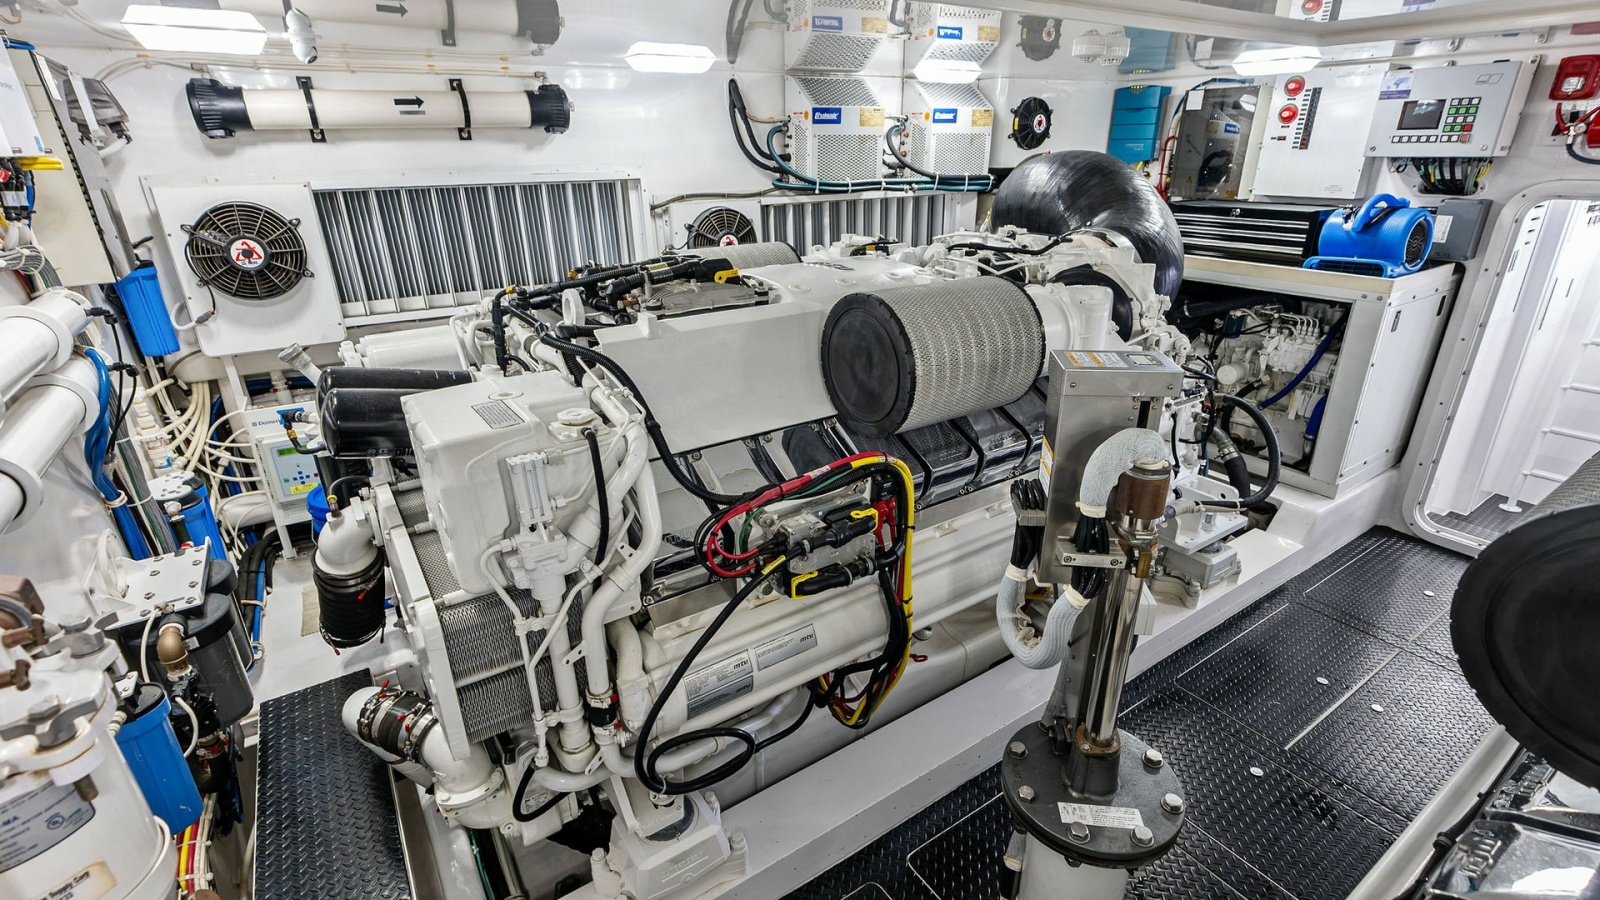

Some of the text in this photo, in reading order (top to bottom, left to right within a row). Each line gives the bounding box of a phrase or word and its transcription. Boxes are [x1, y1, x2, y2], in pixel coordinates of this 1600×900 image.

[799, 634, 814, 643] mtu
[733, 660, 748, 669] mtu
[49, 882, 73, 898] Supply
[73, 871, 89, 883] Corp
